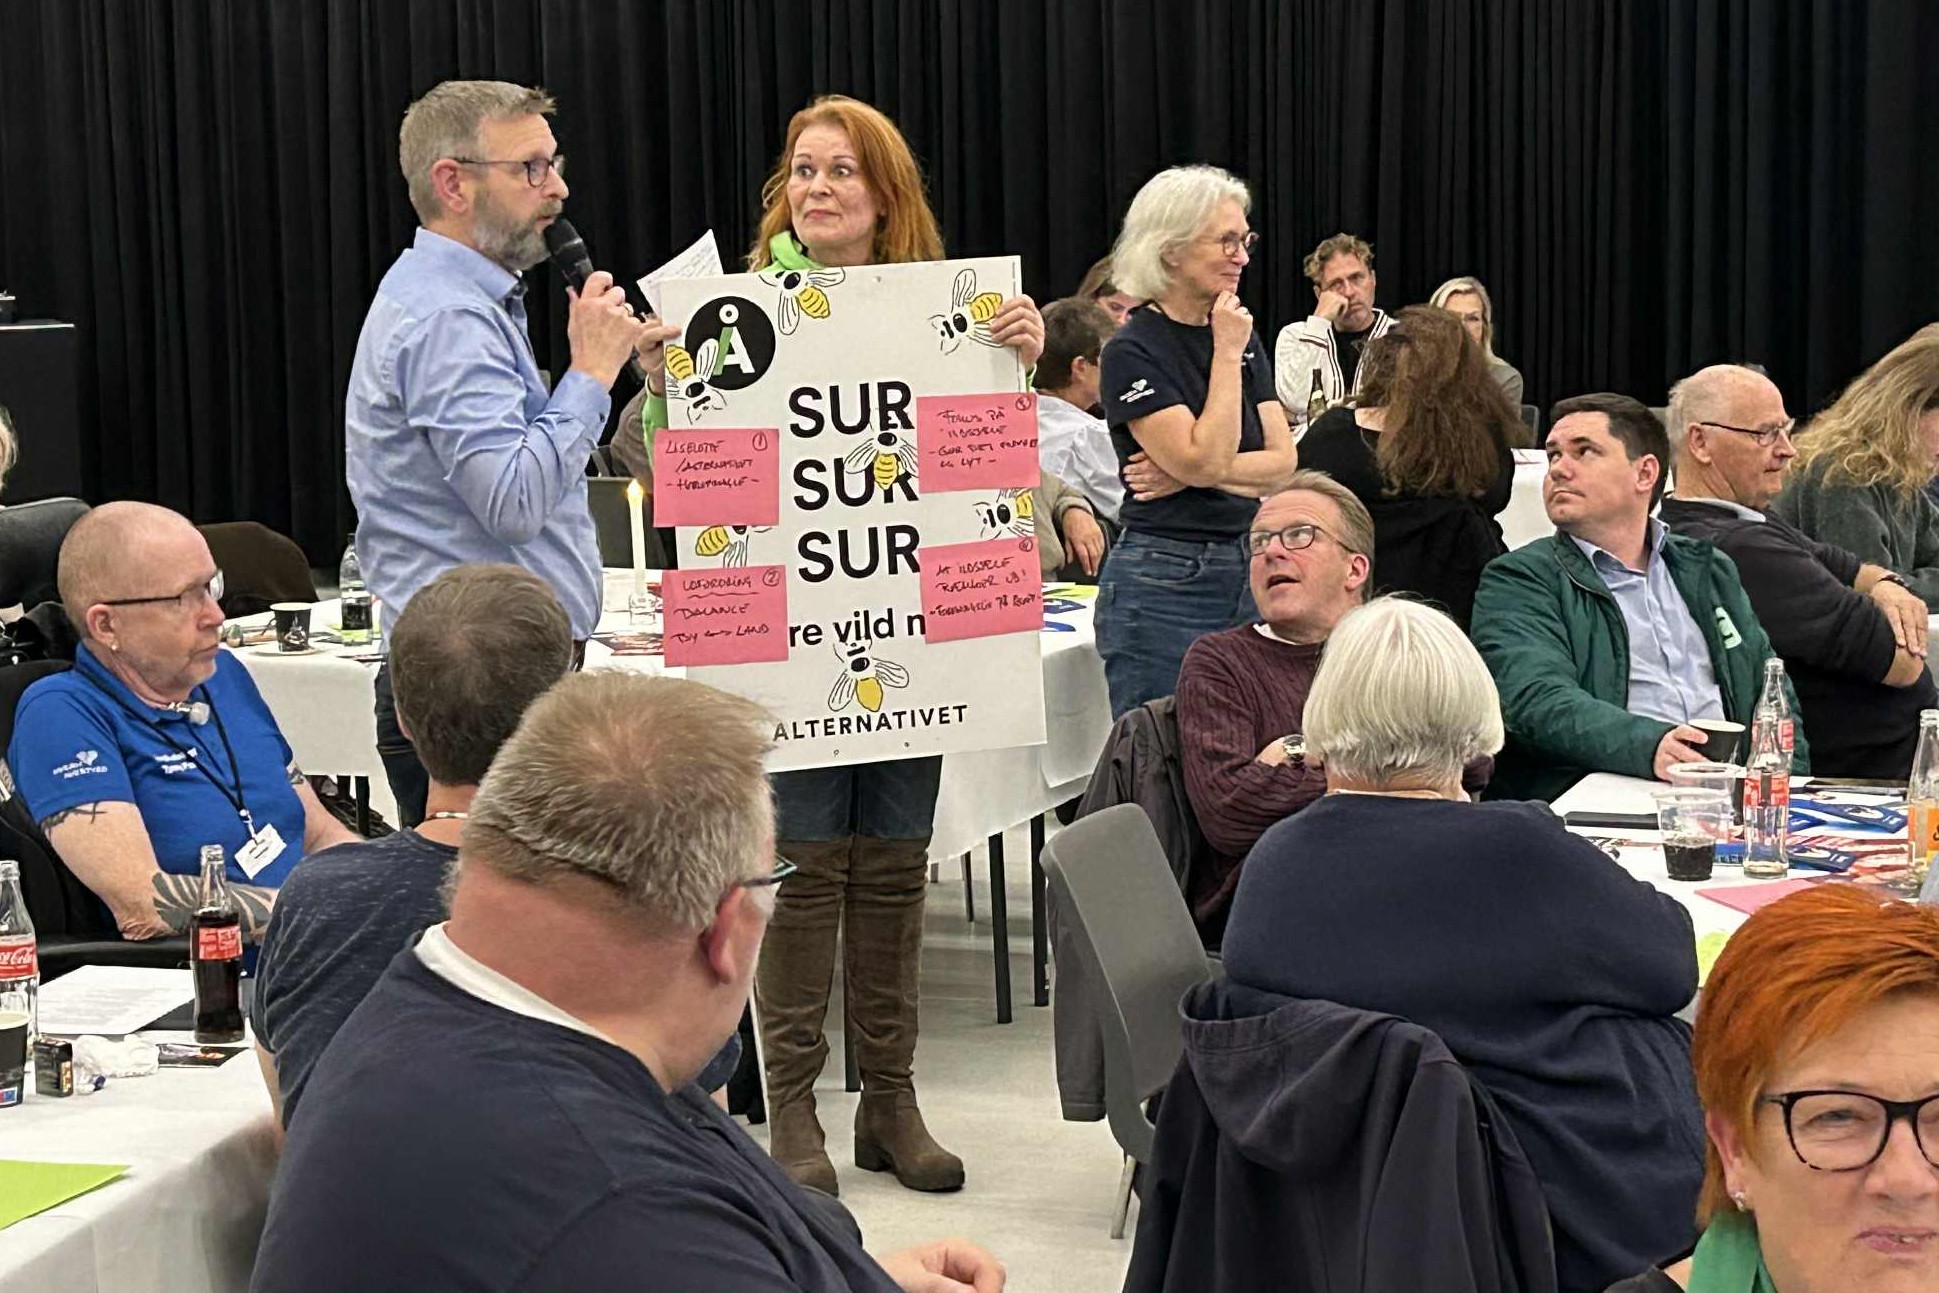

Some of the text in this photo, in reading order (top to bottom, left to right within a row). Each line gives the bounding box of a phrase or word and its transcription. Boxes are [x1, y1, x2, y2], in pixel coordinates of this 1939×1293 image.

[712, 304, 756, 376] Å
[789, 381, 915, 438] SUR
[798, 524, 921, 583] SUR
[735, 623, 770, 637] LAND
[789, 608, 926, 648] re vild n
[773, 705, 968, 742] ALTERNATIVET
